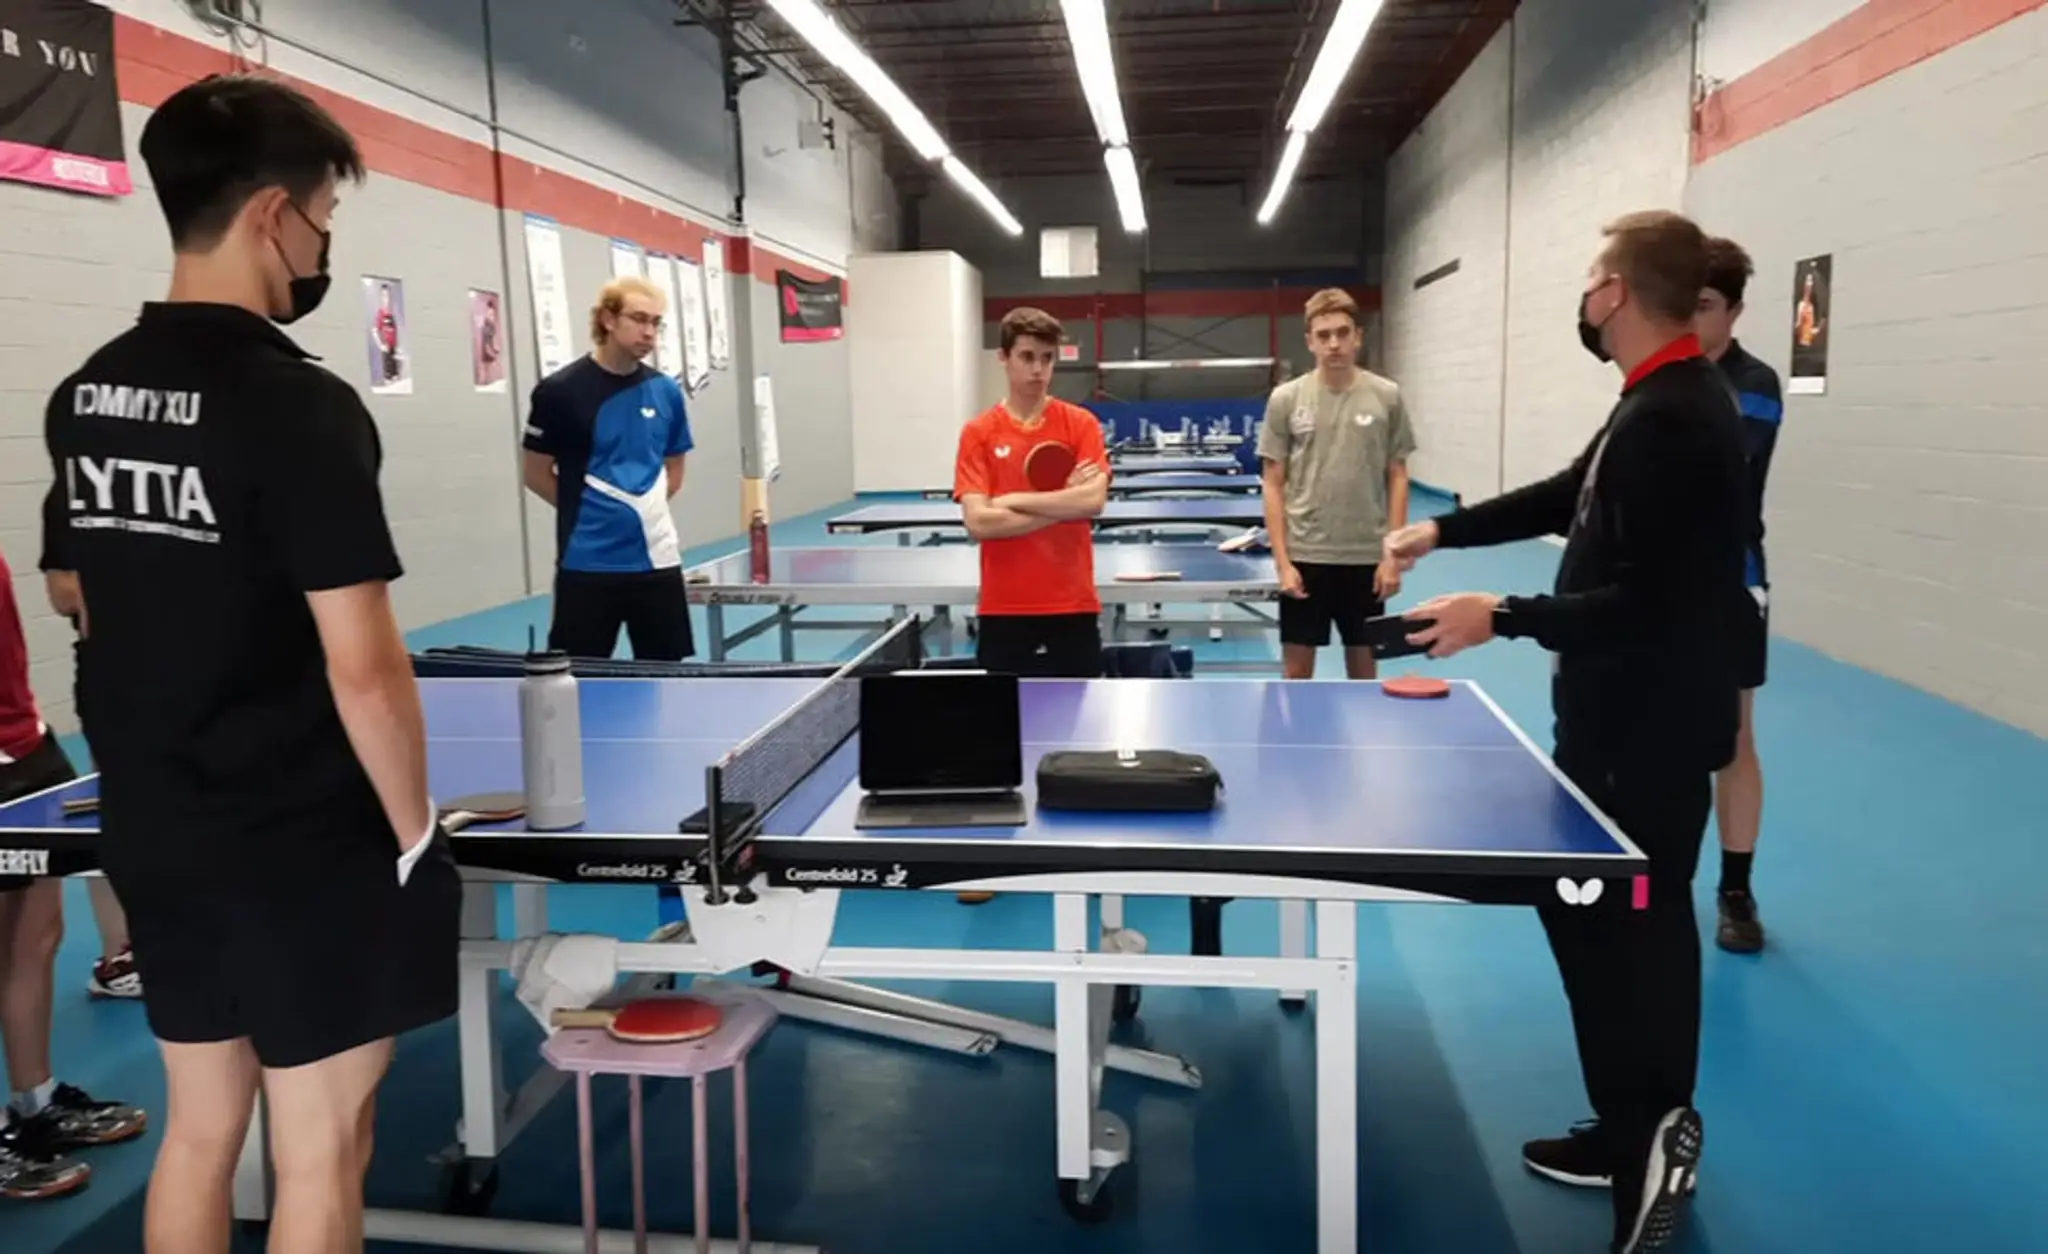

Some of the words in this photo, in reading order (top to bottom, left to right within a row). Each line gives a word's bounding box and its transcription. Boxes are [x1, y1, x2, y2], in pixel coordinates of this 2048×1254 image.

[37, 39, 98, 78] YOU
[163, 389, 202, 426] XU
[66, 455, 218, 525] LYTTA
[650, 863, 669, 877] 25
[860, 867, 879, 883] 25
